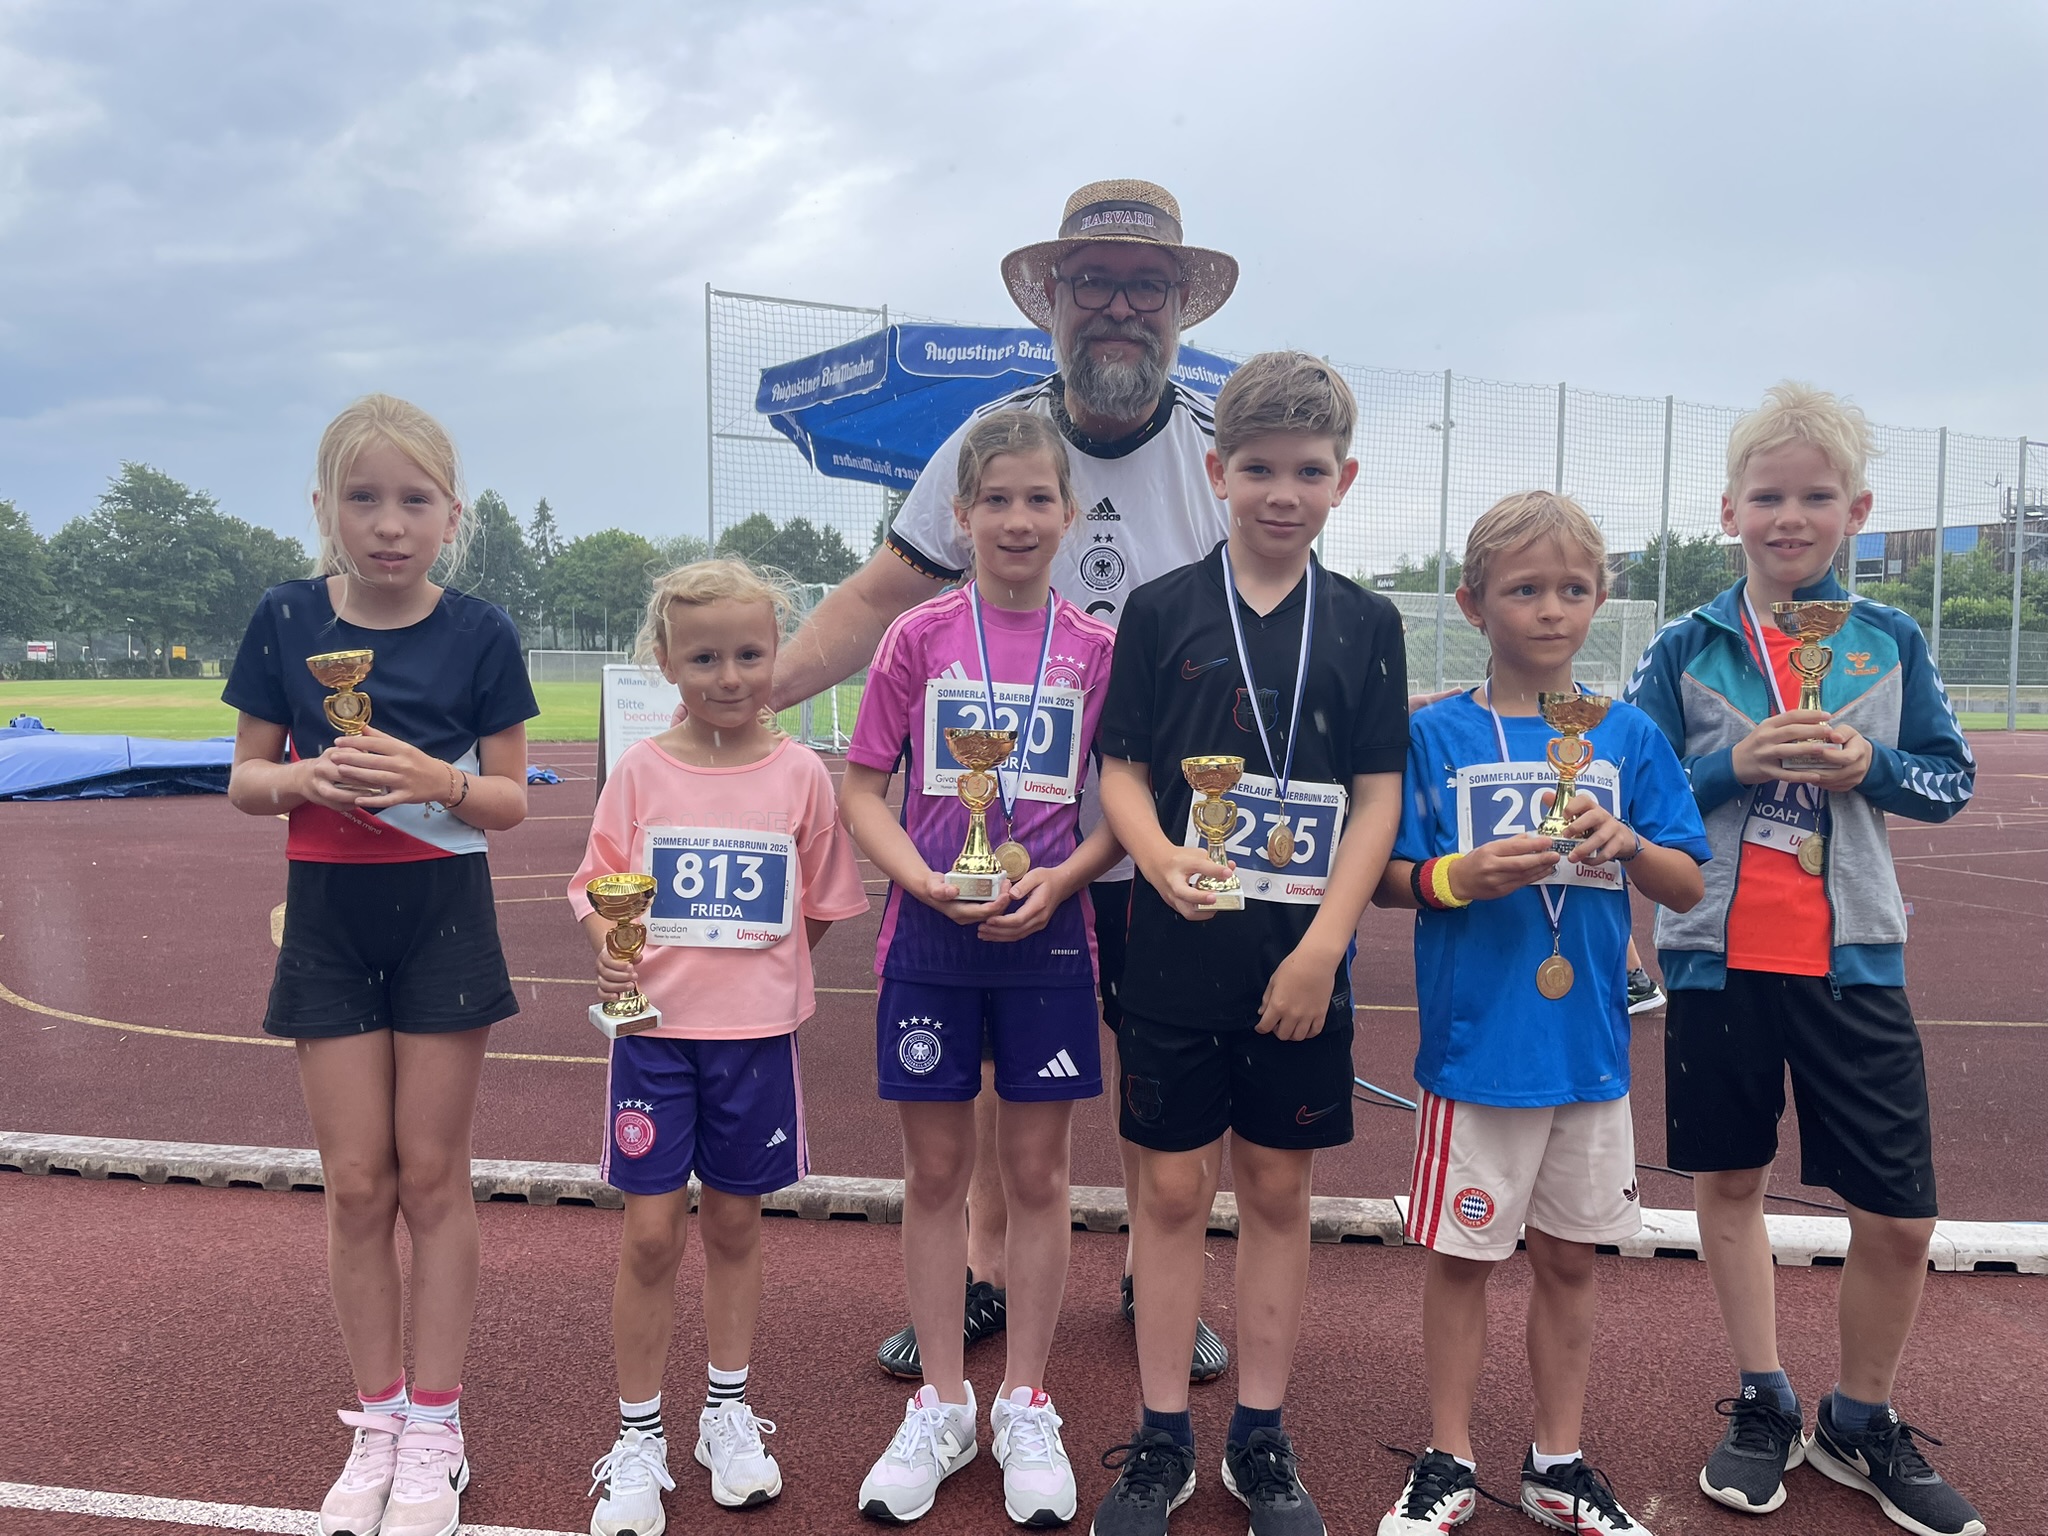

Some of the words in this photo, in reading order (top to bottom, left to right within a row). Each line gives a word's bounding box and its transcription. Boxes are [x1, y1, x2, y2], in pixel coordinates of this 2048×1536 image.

[1080, 211, 1155, 230] HARVARD
[1086, 512, 1121, 522] adidas
[617, 678, 648, 686] Allianz
[617, 699, 645, 710] Bitte
[1056, 697, 1075, 708] 2025
[624, 711, 672, 722] beachte
[1469, 772, 1535, 785] SOMMERLAUF
[1597, 776, 1614, 787] 2025
[1024, 781, 1067, 796] Umschau
[1323, 794, 1339, 804] 2025
[1754, 802, 1800, 824] NOAH
[653, 836, 710, 847] SOMMERLAUF
[712, 838, 768, 851] BAIERBRUNN
[769, 843, 788, 853] 2025
[673, 852, 764, 901] 813
[690, 903, 743, 918] FRIEDA
[649, 922, 688, 933] Givaudan
[736, 928, 781, 942] Umschau
